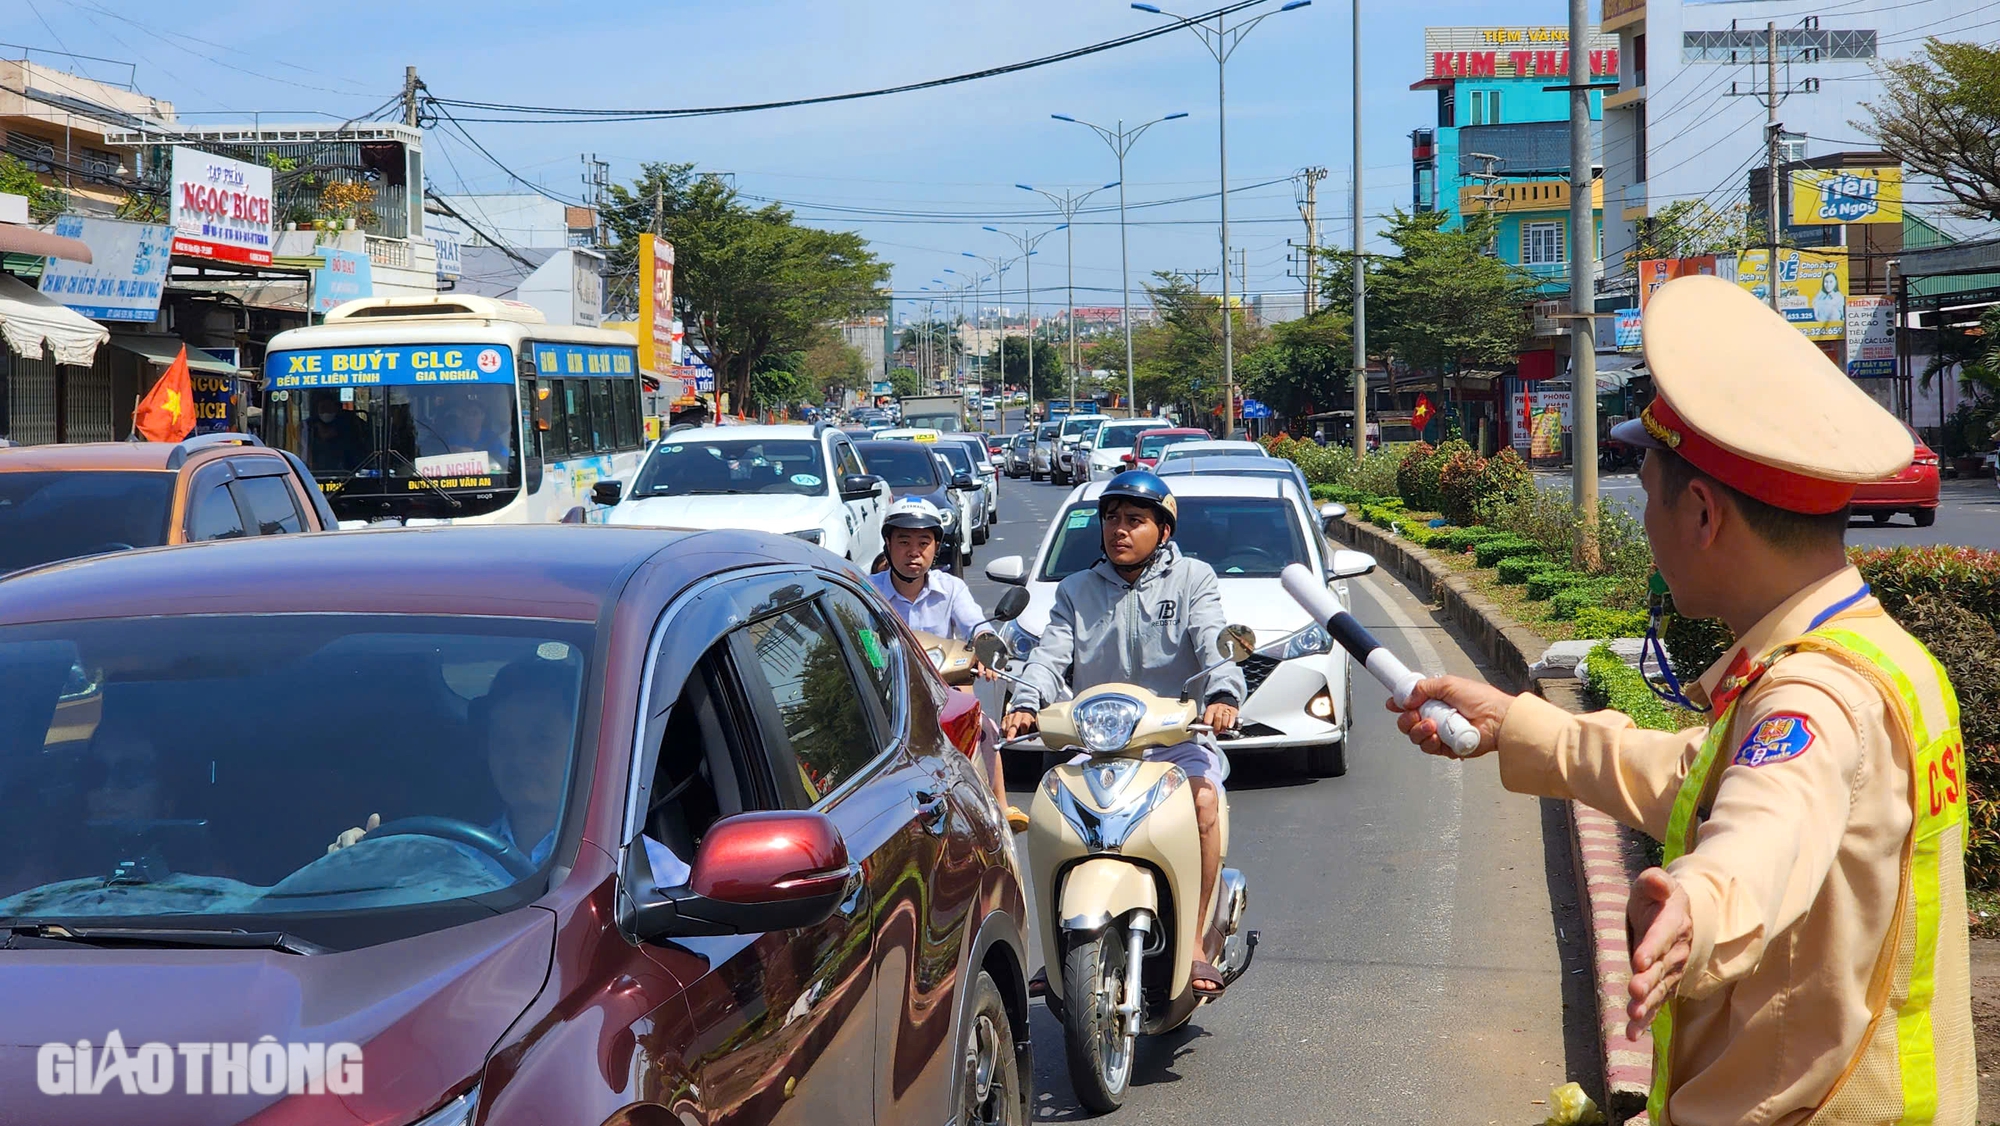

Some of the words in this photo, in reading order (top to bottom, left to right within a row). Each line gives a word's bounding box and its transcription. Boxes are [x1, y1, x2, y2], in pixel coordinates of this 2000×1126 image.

[1483, 27, 1521, 45] TIỆM
[1434, 51, 1496, 77] KIM
[183, 182, 229, 222] NGỌC
[232, 184, 269, 224] BÍCH
[1819, 203, 1837, 217] Có
[1839, 200, 1877, 216] Ngay
[289, 355, 322, 373] XE
[331, 349, 400, 371] BUÝT
[411, 350, 463, 369] CLC
[481, 354, 498, 367] 24
[277, 372, 300, 387] BẾN
[302, 375, 318, 385] XE
[321, 372, 348, 384] LIÊN
[415, 371, 437, 381] GIA
[439, 369, 479, 380] NGHĨA
[1543, 392, 1571, 400] PHÒNG
[422, 465, 442, 477] GIA
[446, 458, 484, 476] NGHĨA
[440, 479, 458, 488] CHU
[459, 477, 477, 487] VĂN
[478, 478, 491, 487] AN
